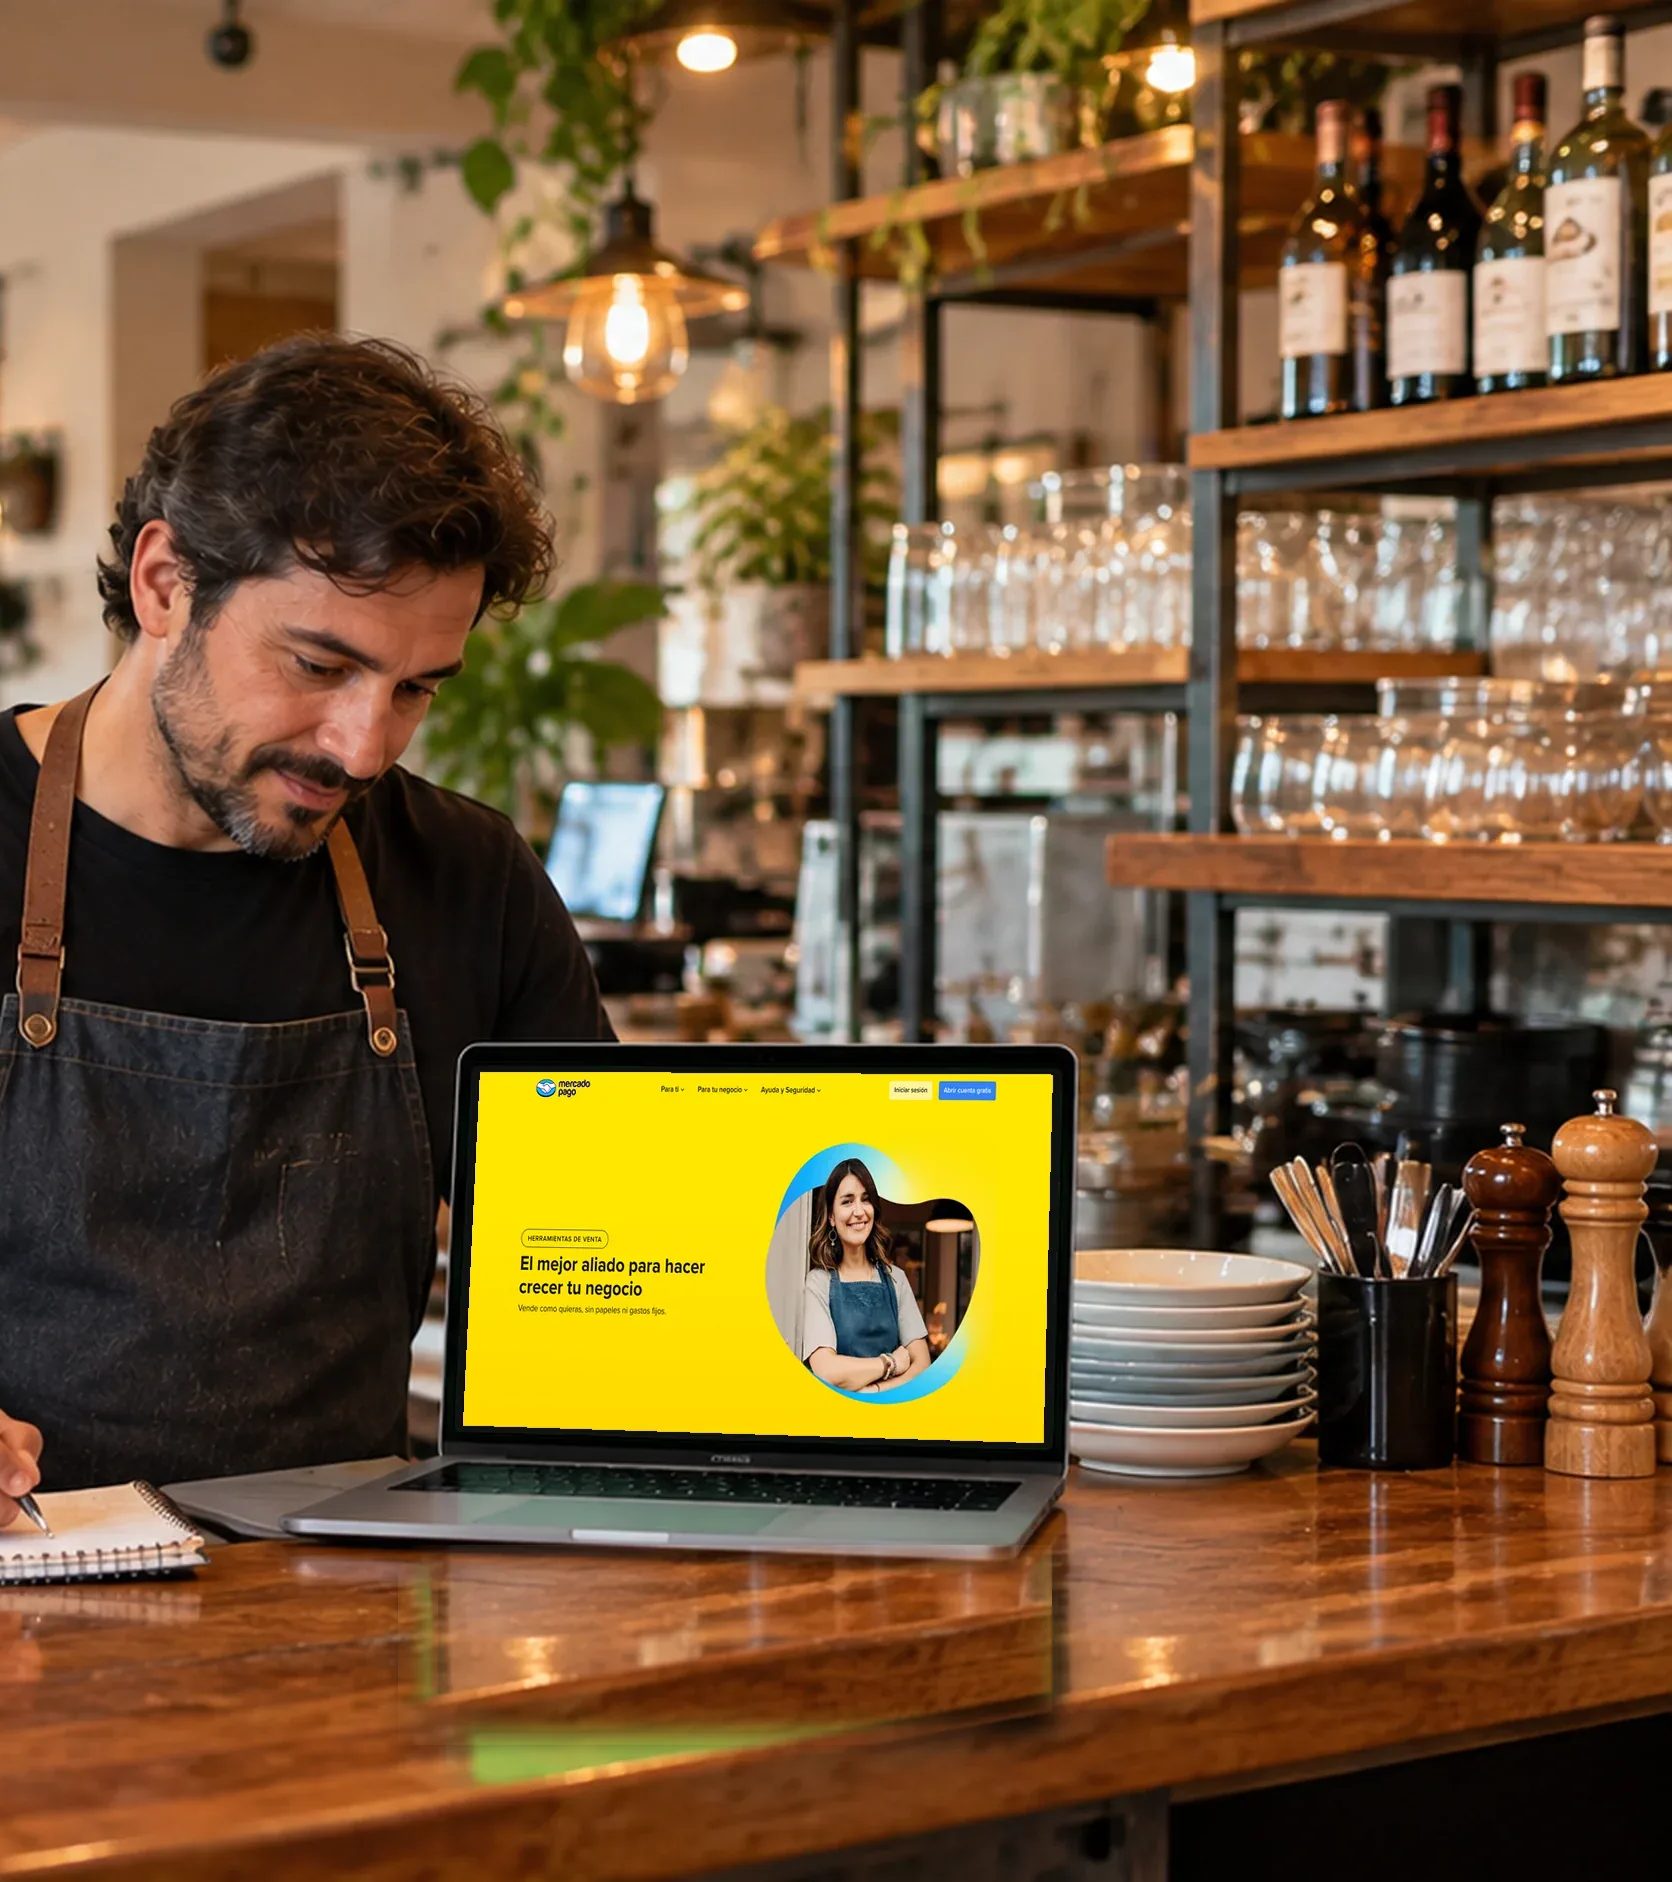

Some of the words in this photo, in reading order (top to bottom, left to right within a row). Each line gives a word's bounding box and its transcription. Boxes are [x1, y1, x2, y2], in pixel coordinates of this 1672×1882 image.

[558, 1079, 591, 1088] mercado
[558, 1088, 576, 1097] pago
[660, 1085, 673, 1093] Para
[697, 1085, 711, 1093] Para
[718, 1086, 743, 1095] negocio
[760, 1086, 779, 1095] Ayuda
[785, 1086, 816, 1095] Seguridad
[893, 1086, 910, 1094] Iniciar
[910, 1086, 928, 1094] sesión
[976, 1087, 992, 1095] gratis
[527, 1235, 572, 1243] HERRAMIENTAS
[520, 1255, 533, 1271] El
[537, 1256, 578, 1275] mejor
[581, 1257, 625, 1273] aliado
[628, 1260, 661, 1276] para
[665, 1258, 706, 1274] hacer
[519, 1282, 564, 1295] crecer
[567, 1280, 581, 1295] tu
[585, 1281, 643, 1299] negocio
[517, 1304, 539, 1313] Vende
[539, 1305, 558, 1313] como
[558, 1305, 584, 1314] quieras,
[584, 1306, 595, 1314] sin
[595, 1306, 621, 1315] papeles
[629, 1307, 651, 1316] gastos
[651, 1307, 666, 1316] fijos.
